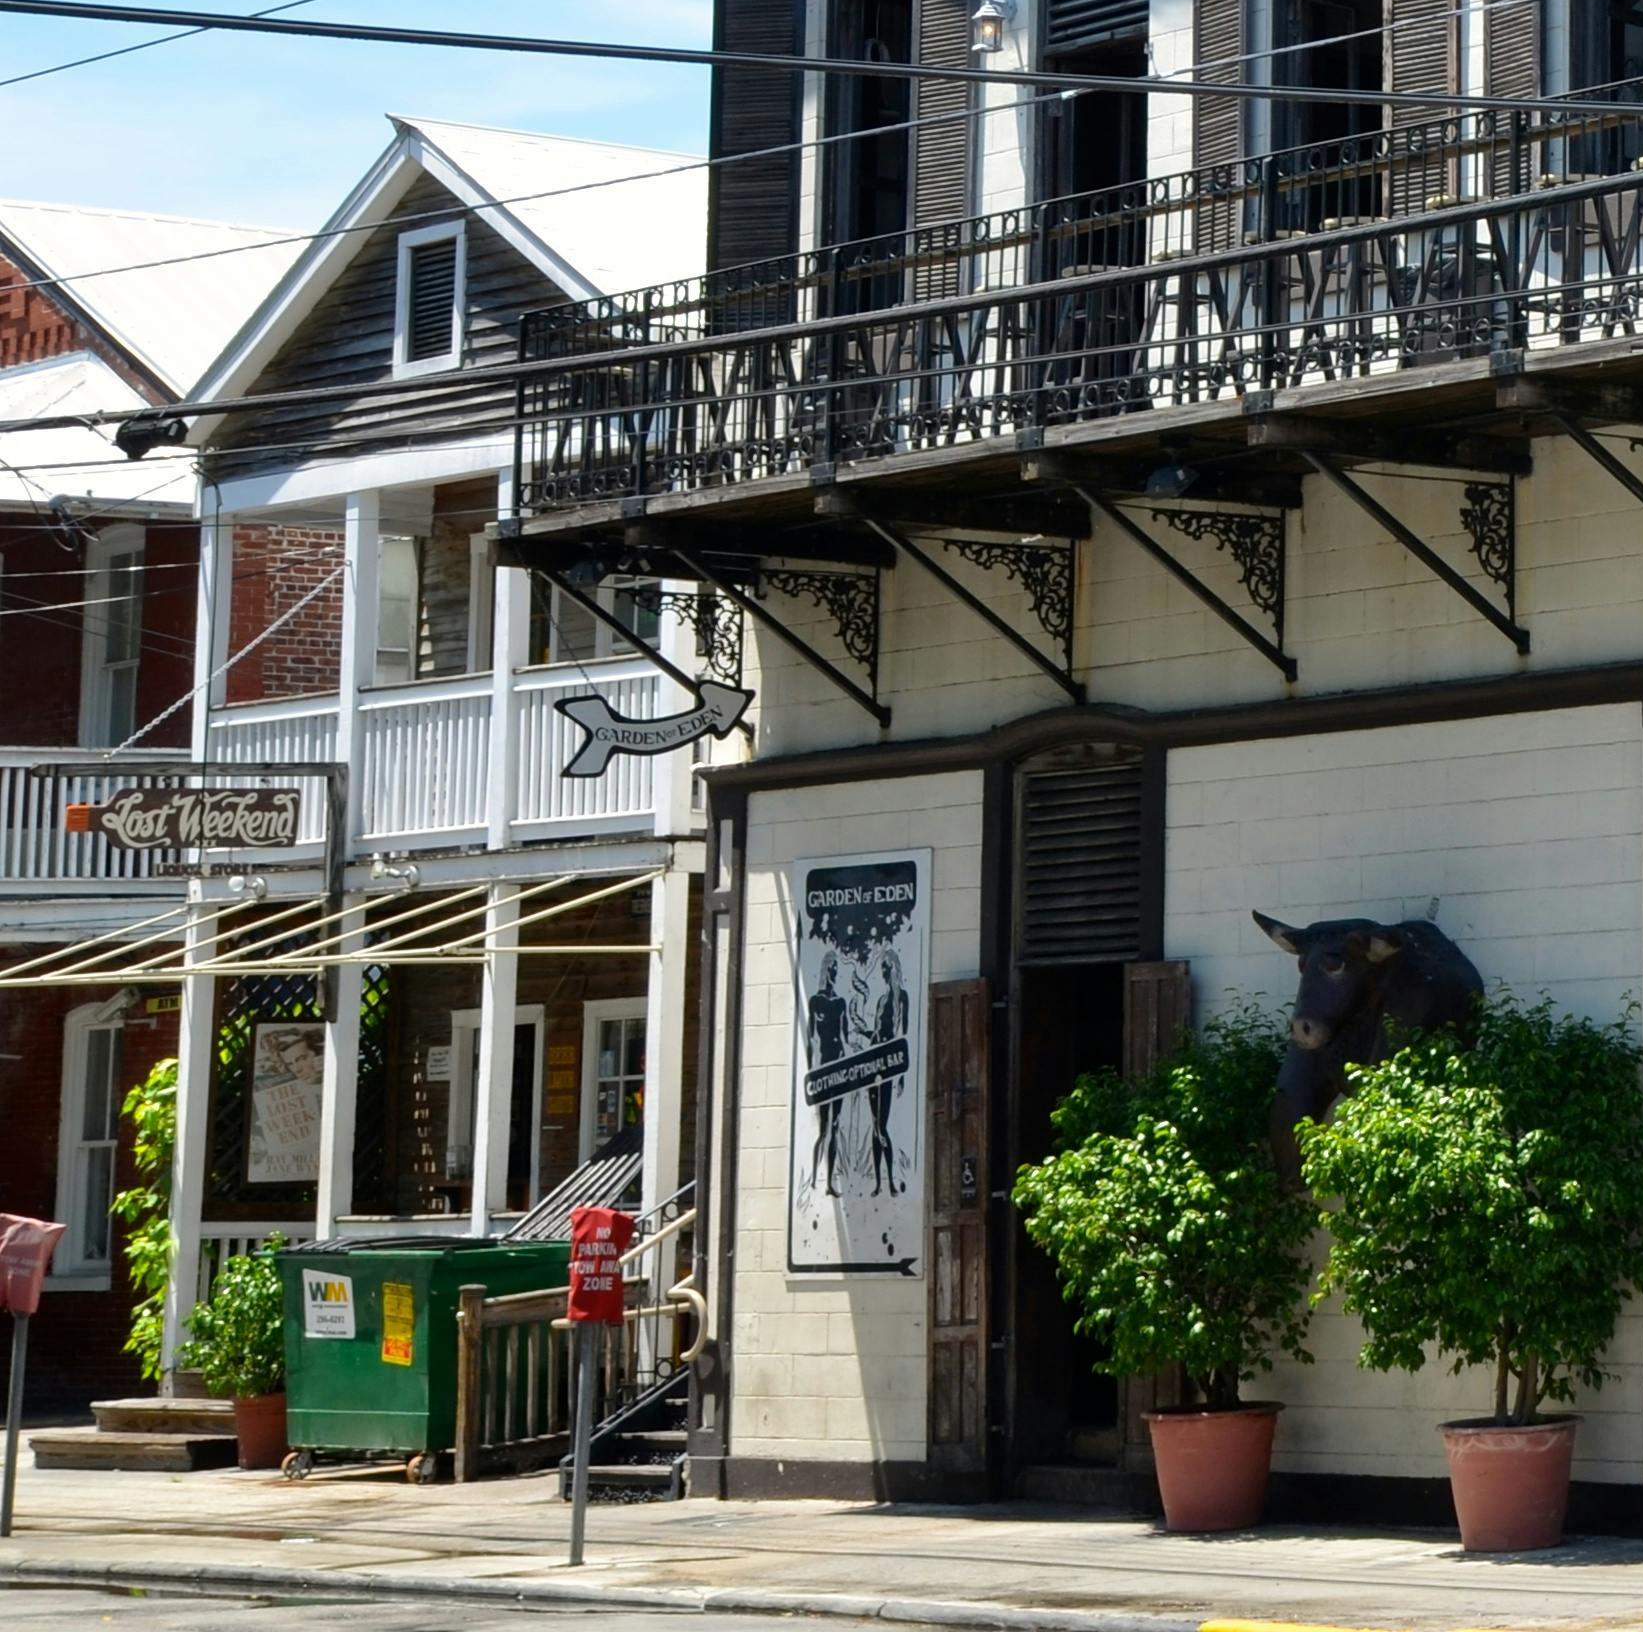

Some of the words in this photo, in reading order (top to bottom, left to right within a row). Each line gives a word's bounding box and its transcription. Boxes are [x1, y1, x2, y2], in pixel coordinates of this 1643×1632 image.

[595, 727, 666, 744] GARDEN
[677, 705, 724, 736] EDEN
[101, 792, 178, 849] Lost
[172, 791, 301, 846] Weekend
[807, 886, 862, 908] GARDEN
[873, 882, 914, 903] EDEN
[886, 1051, 905, 1068] BAR
[269, 1085, 301, 1102] THE
[266, 1096, 306, 1118] LOST
[278, 1127, 311, 1145] END
[595, 1227, 612, 1239] NO
[578, 1242, 617, 1257] PARKIN
[574, 1260, 595, 1274] TOW
[600, 1260, 620, 1274] AWA
[308, 1281, 349, 1303] WM
[582, 1277, 614, 1291] ZONE
